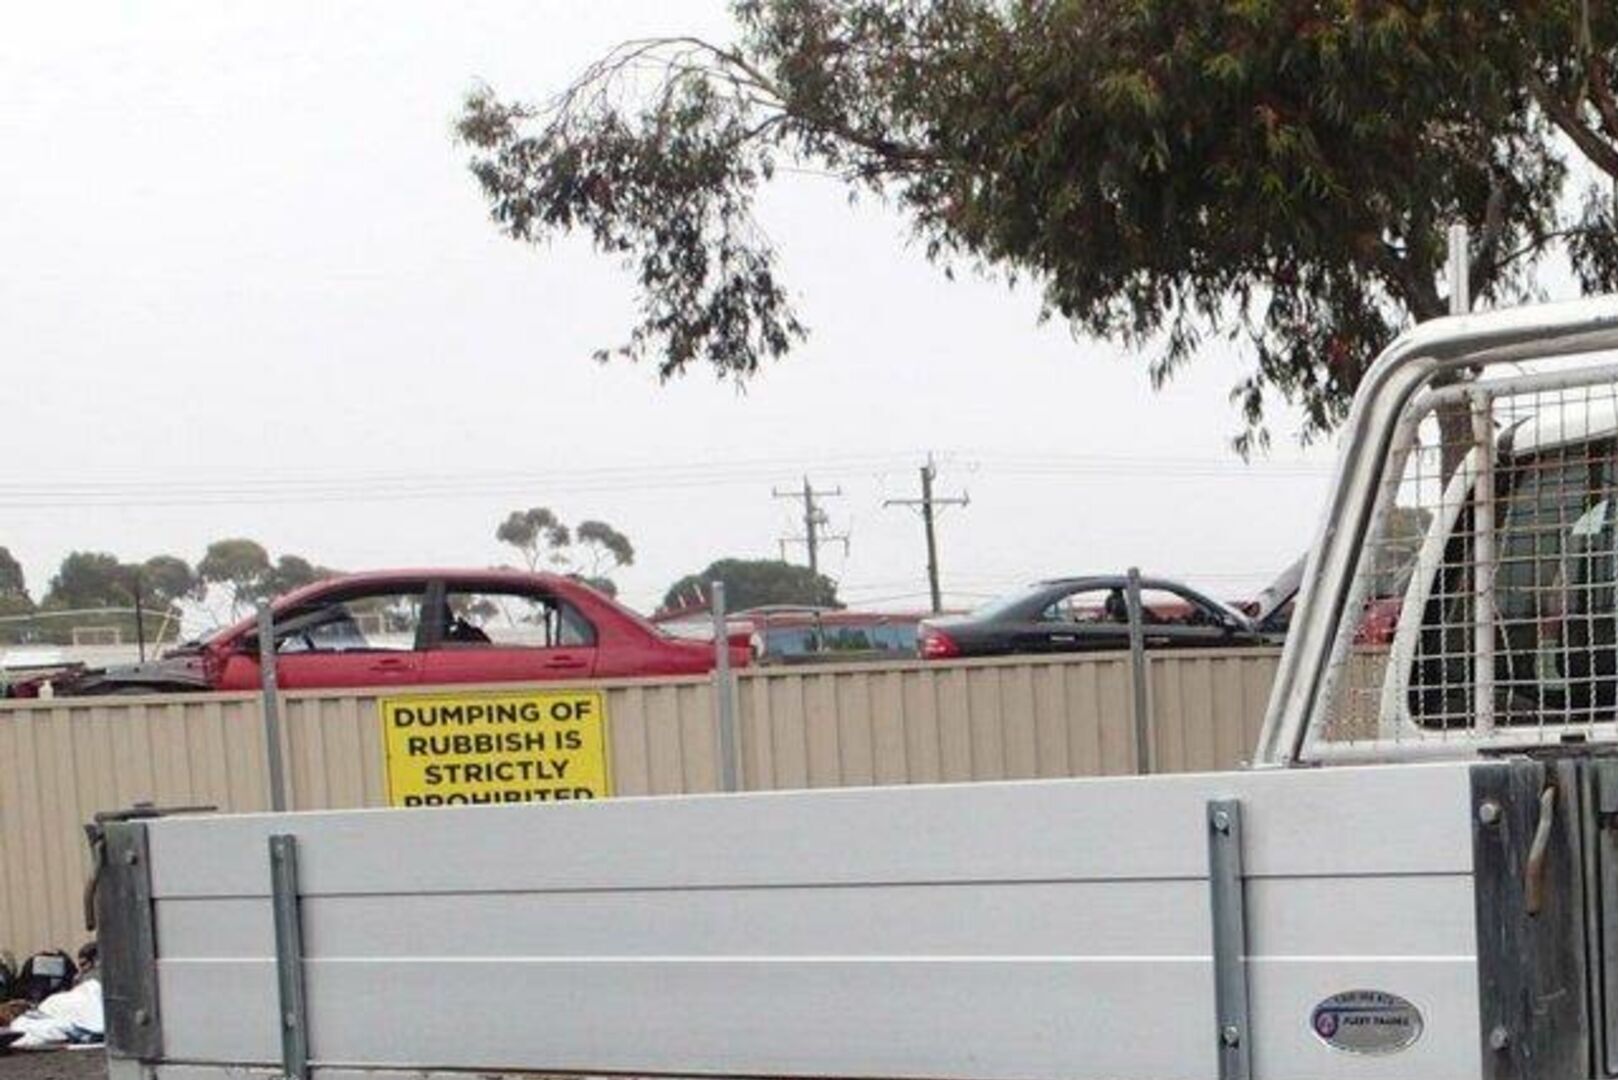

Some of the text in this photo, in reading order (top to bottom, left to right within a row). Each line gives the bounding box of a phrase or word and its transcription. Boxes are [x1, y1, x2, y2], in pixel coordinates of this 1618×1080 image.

[394, 700, 592, 727] DUMPING OF
[408, 730, 582, 756] RUBBISH IS
[425, 759, 570, 785] STRICTLY
